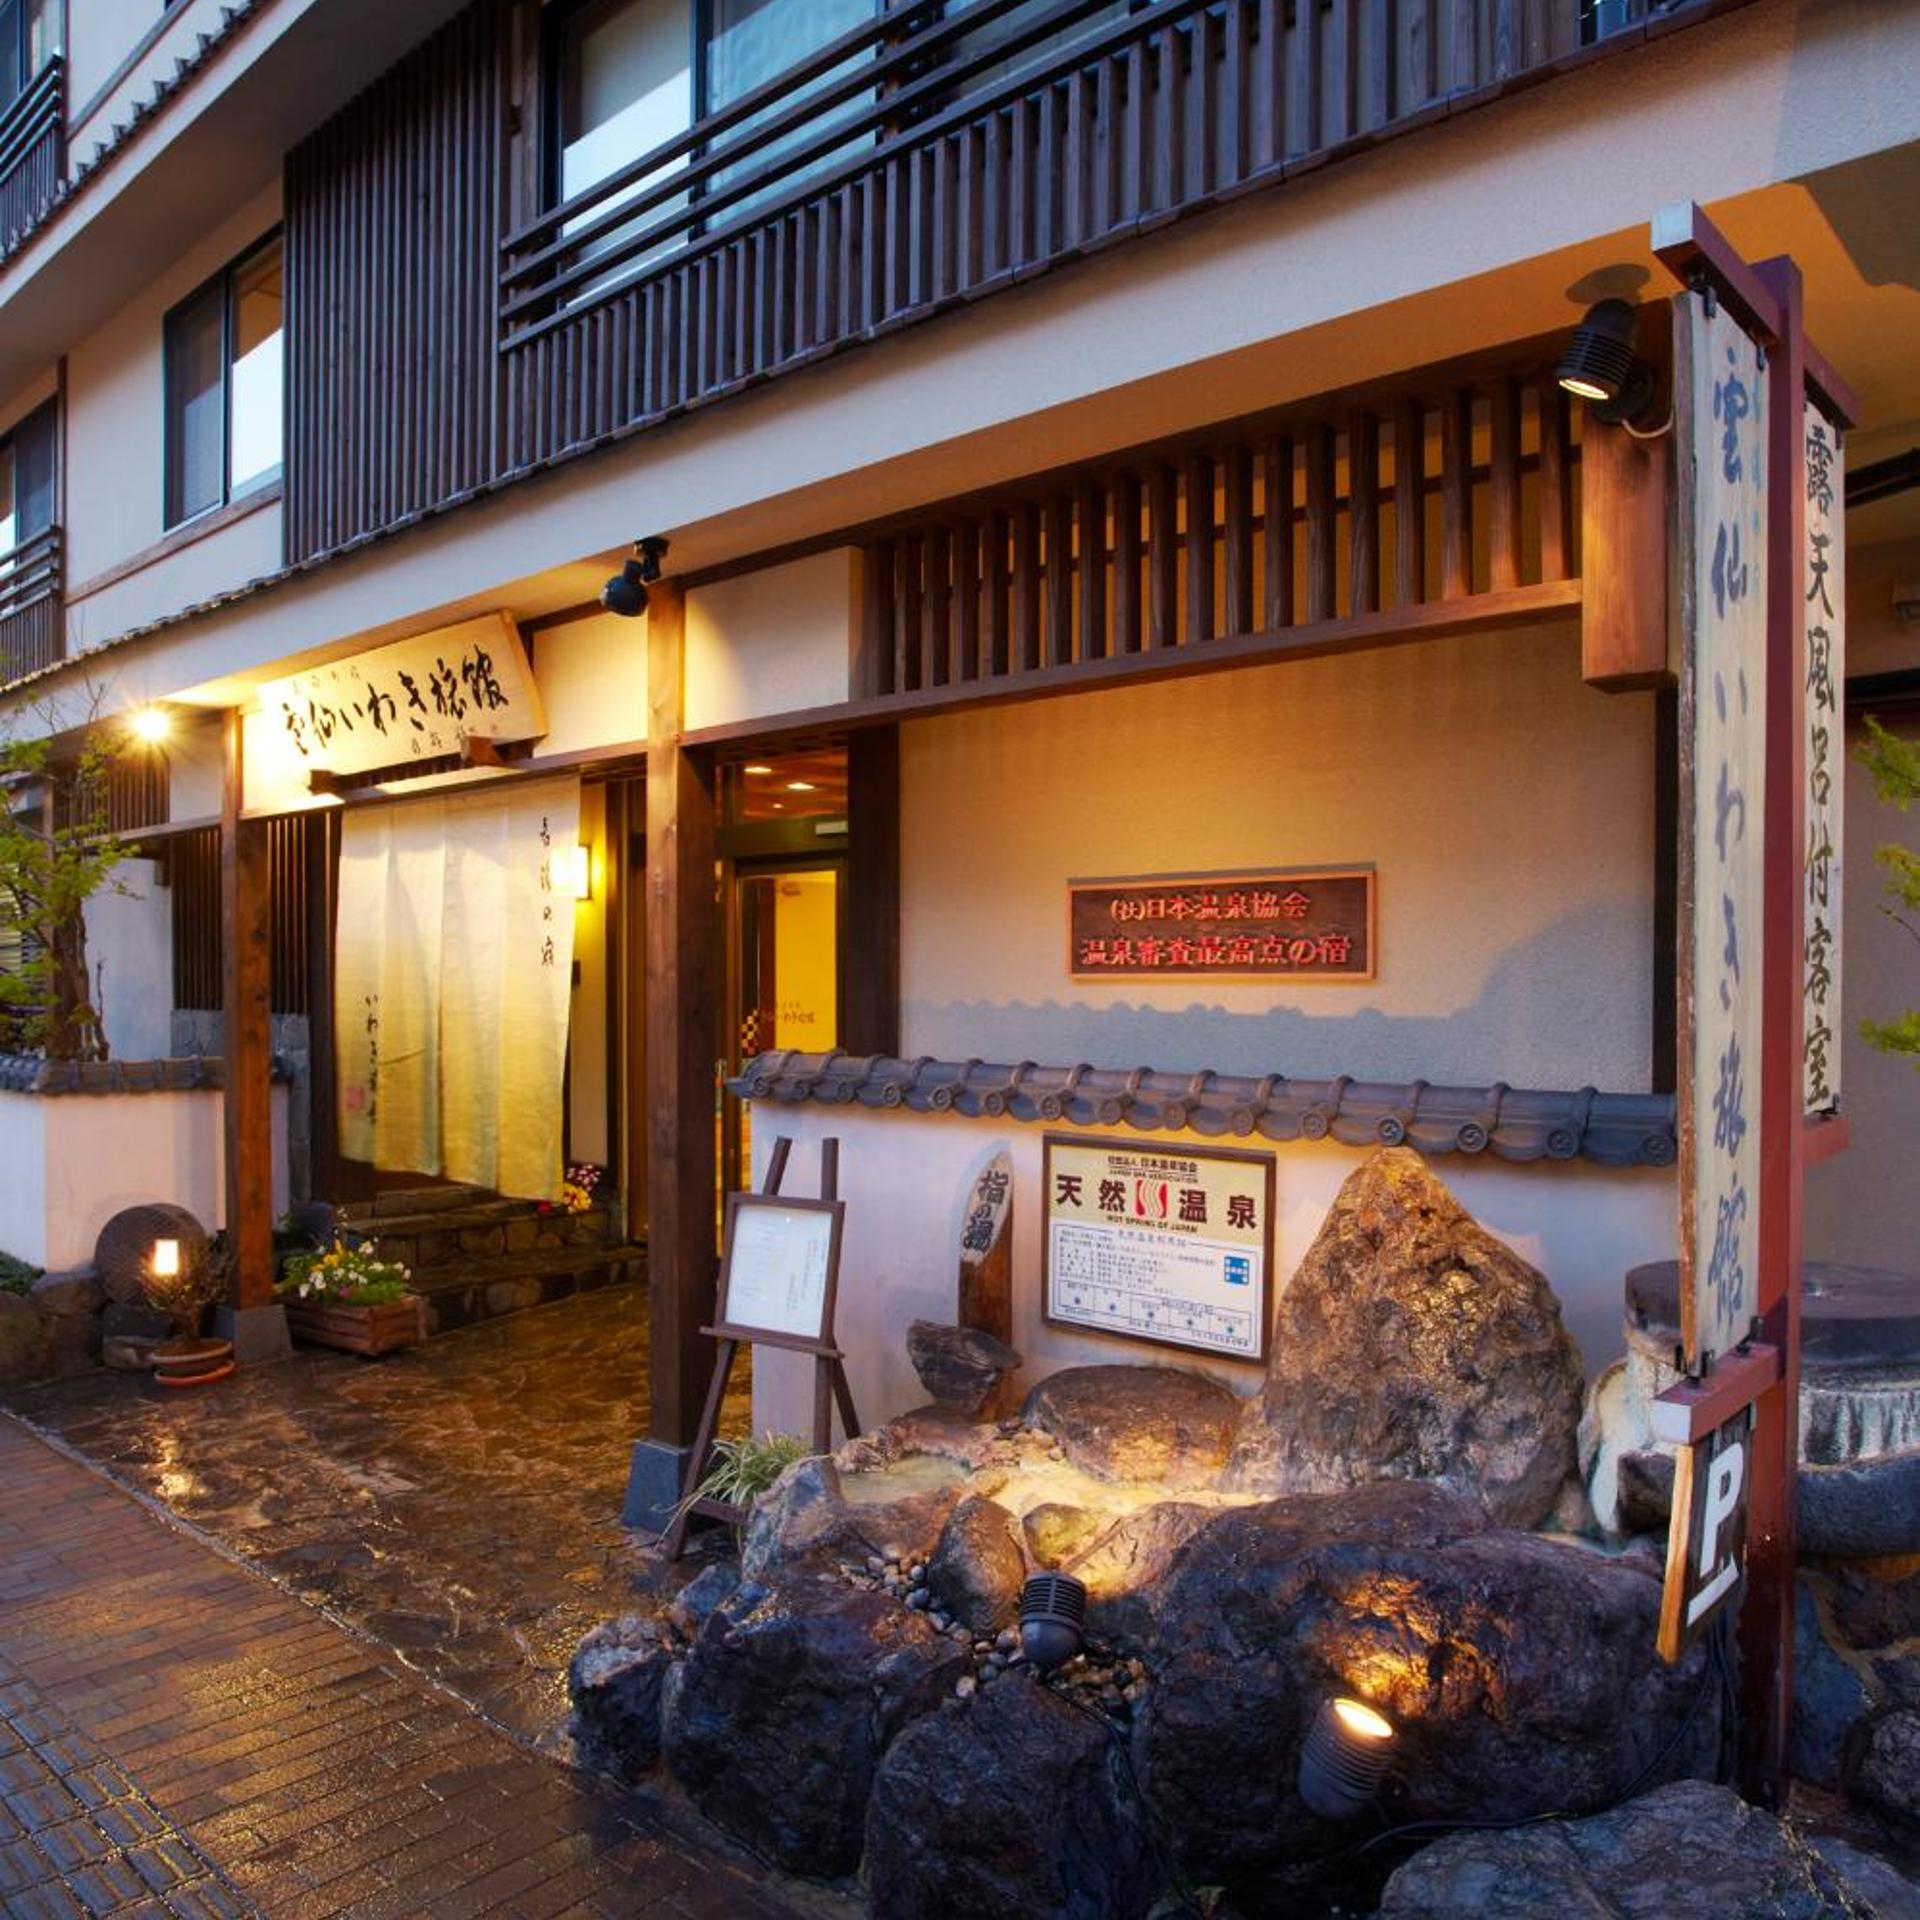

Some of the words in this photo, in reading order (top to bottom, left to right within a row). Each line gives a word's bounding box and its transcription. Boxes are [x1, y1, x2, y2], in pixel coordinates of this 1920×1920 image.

[283, 645, 509, 756] 雲仙いわき旅館
[1803, 424, 1834, 1106] 露天風呂付客室
[1707, 346, 1748, 1329] 雲仙いわき旅館
[1080, 933, 1351, 966] 温泉審査最高点の宿
[1109, 891, 1311, 921] (社)日本温泉協会
[963, 1169, 1009, 1254] 指の湯
[1700, 1441, 1745, 1581] P
